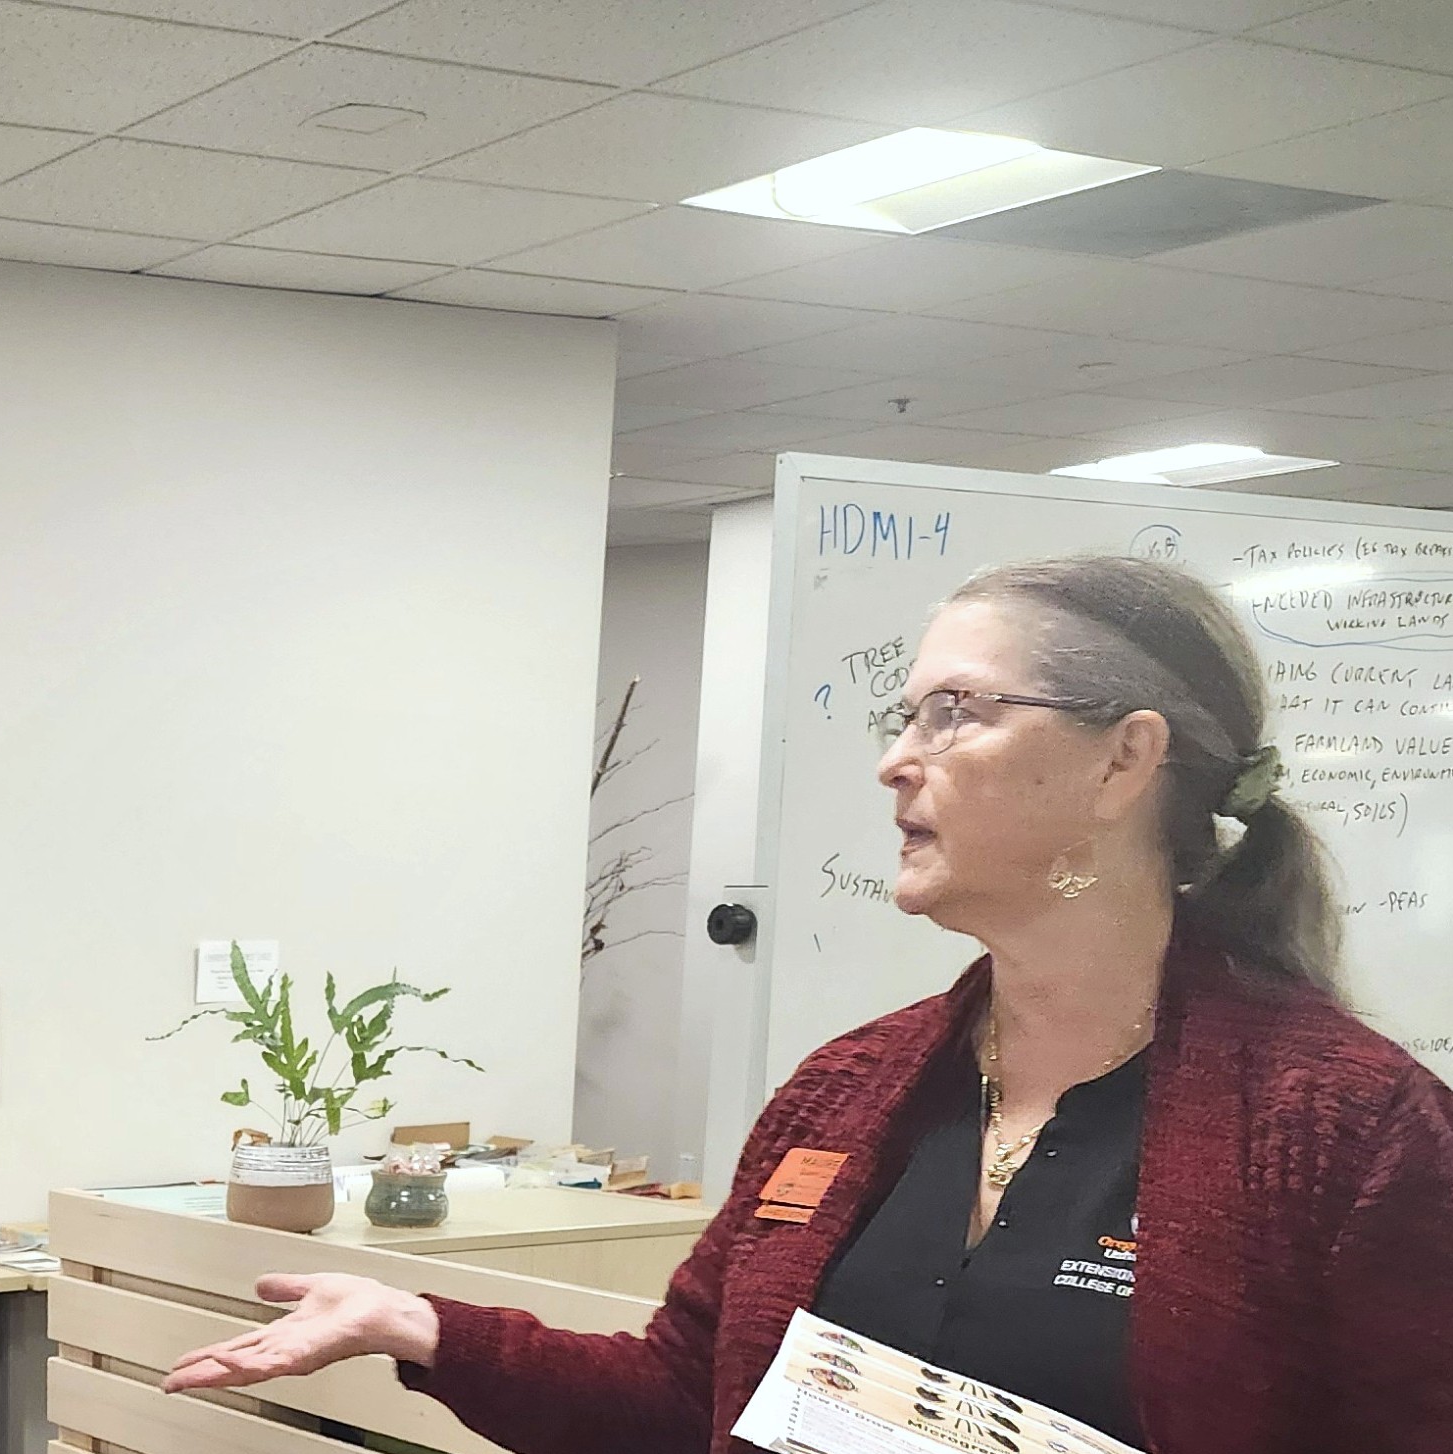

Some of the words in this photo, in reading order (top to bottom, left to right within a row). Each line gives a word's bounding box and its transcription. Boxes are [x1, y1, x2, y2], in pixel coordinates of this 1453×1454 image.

[820, 503, 950, 560] HDMI-4
[842, 636, 904, 684] TREE
[1332, 662, 1418, 688] CURRENT
[1325, 698, 1343, 715] IT
[1355, 699, 1390, 713] CAN
[1296, 734, 1382, 753] FARMLAND
[1060, 1260, 1136, 1282] EXTENSION
[1053, 1274, 1116, 1293] COLLEGE
[1116, 1285, 1135, 1297] OF
